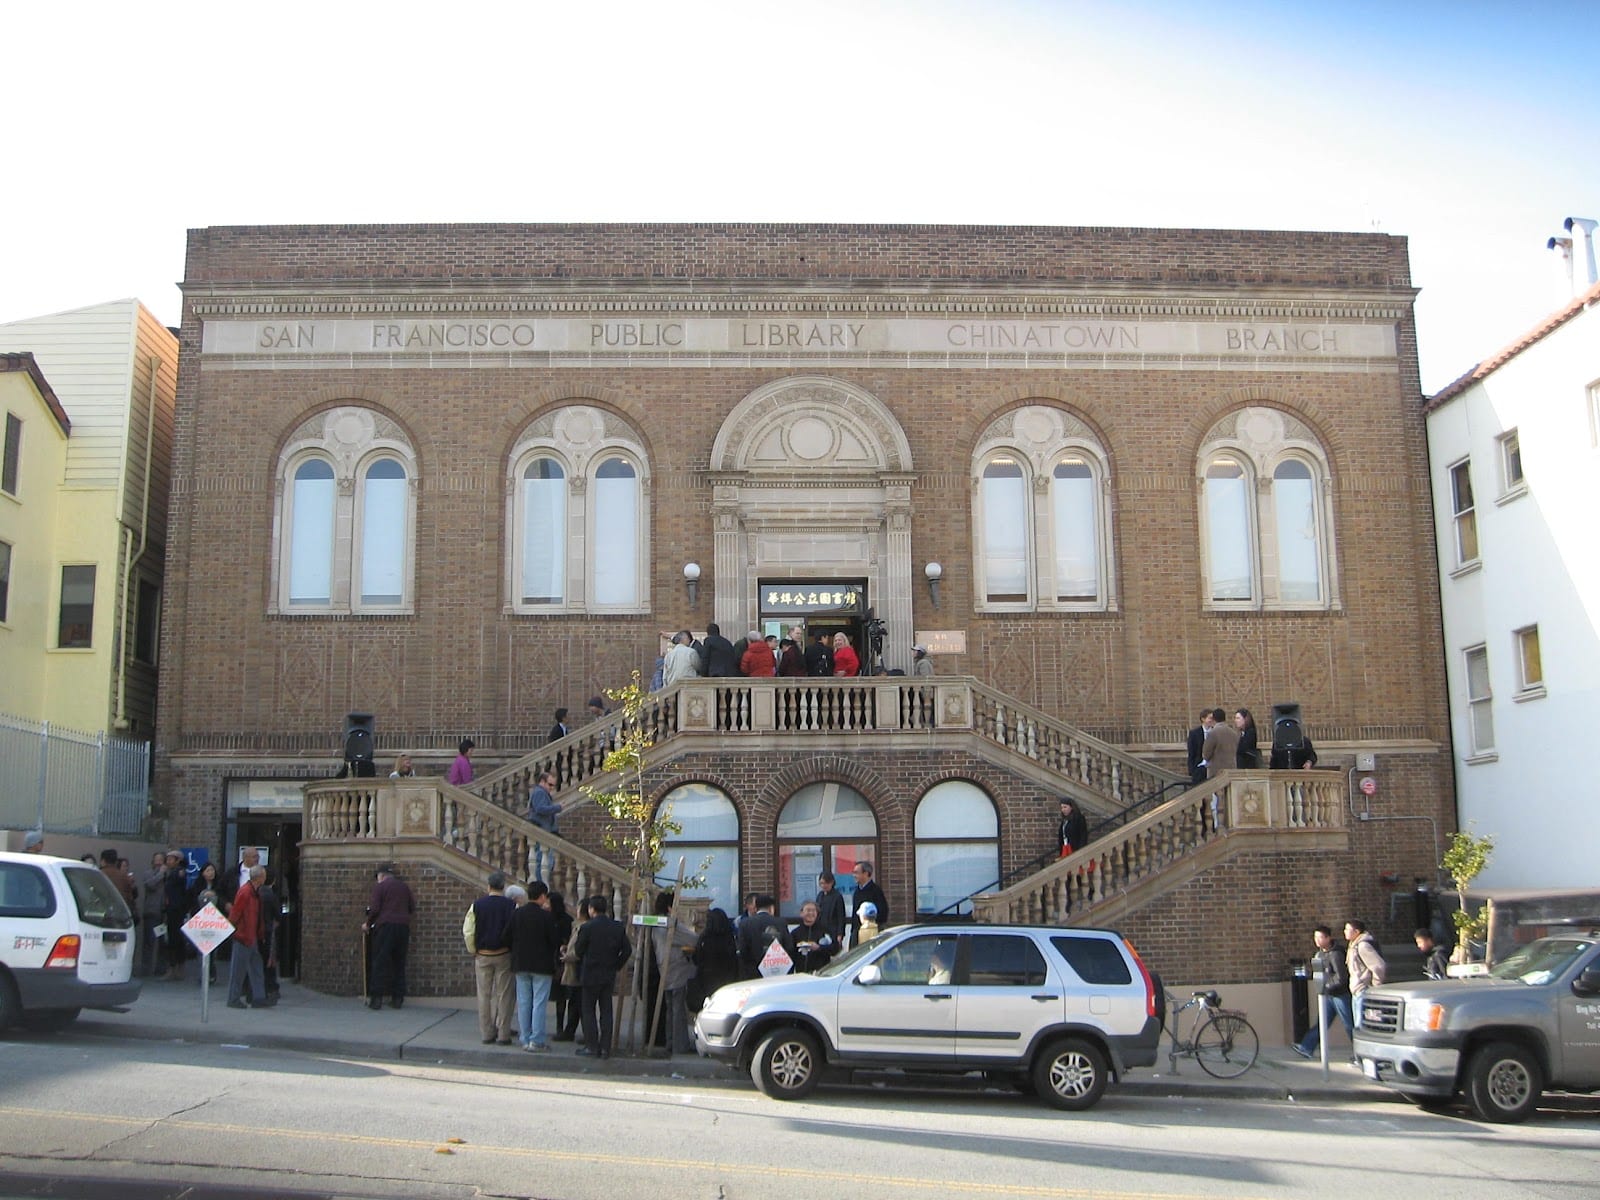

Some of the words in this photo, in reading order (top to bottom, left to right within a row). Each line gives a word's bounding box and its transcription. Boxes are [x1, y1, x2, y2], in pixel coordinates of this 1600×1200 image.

[259, 324, 316, 349] SAN
[372, 323, 535, 348] FRANCISCO
[590, 323, 683, 347] PUBLIC
[742, 323, 865, 347] LIBRARY
[946, 324, 1140, 349] CHINATOWN
[1226, 327, 1339, 353] BRANCH
[203, 906, 217, 916] NO
[188, 919, 229, 930] STOPPING
